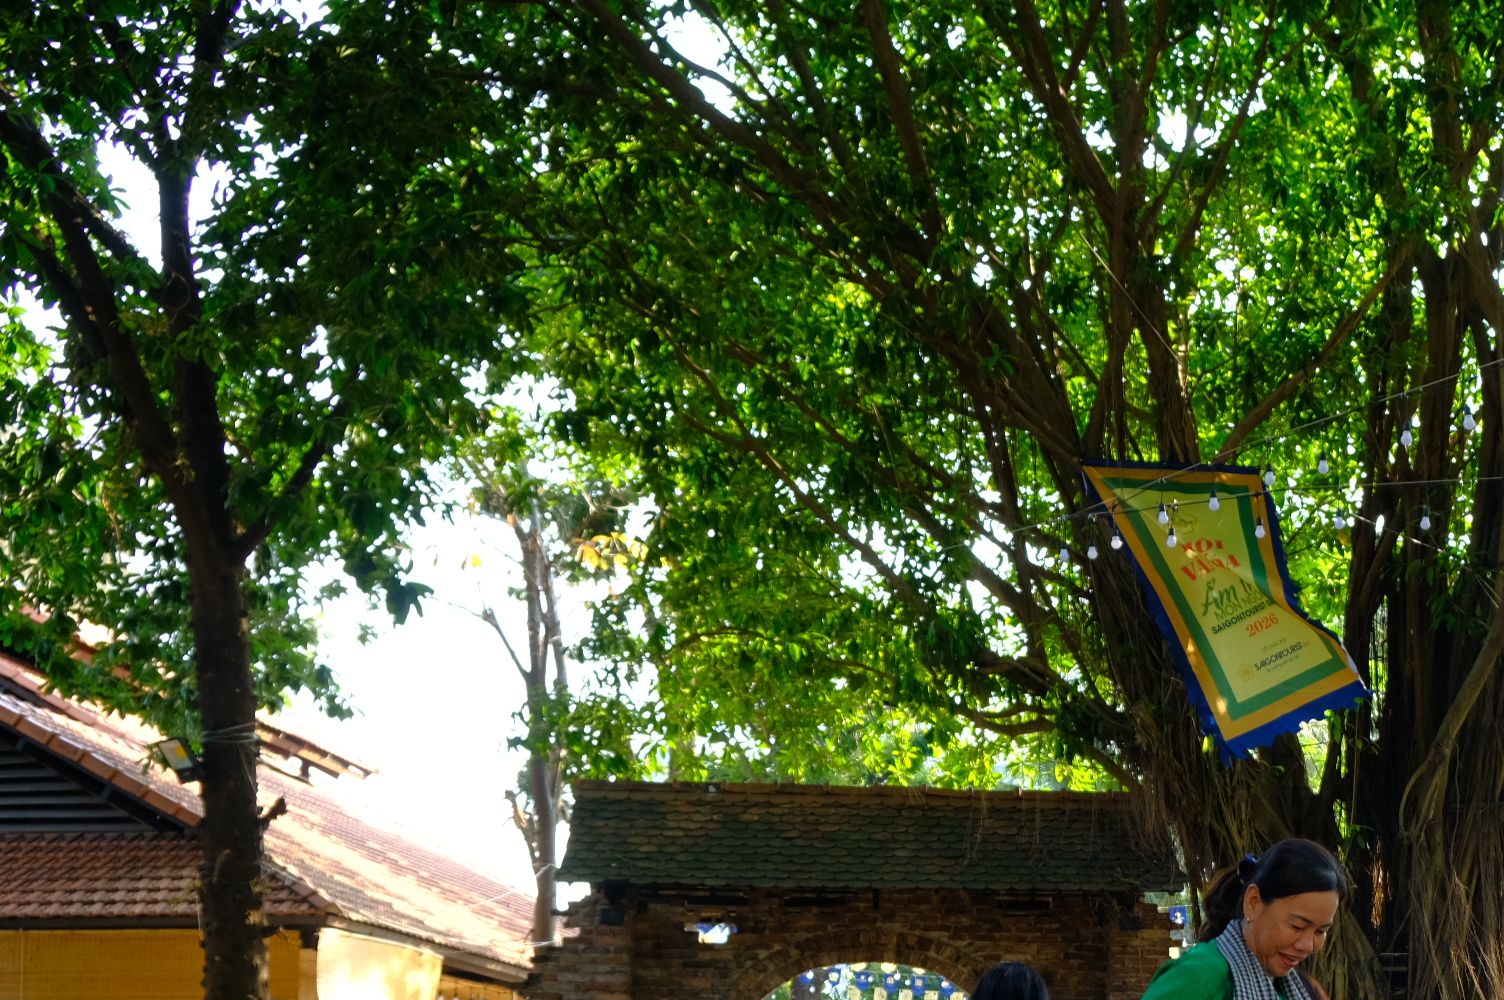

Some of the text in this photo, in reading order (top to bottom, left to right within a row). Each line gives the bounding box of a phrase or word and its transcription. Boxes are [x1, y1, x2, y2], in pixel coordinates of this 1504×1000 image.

[1241, 590, 1266, 609] NGO
[1212, 602, 1266, 634] SAIGONTOURIST
[1246, 612, 1279, 638] 2026
